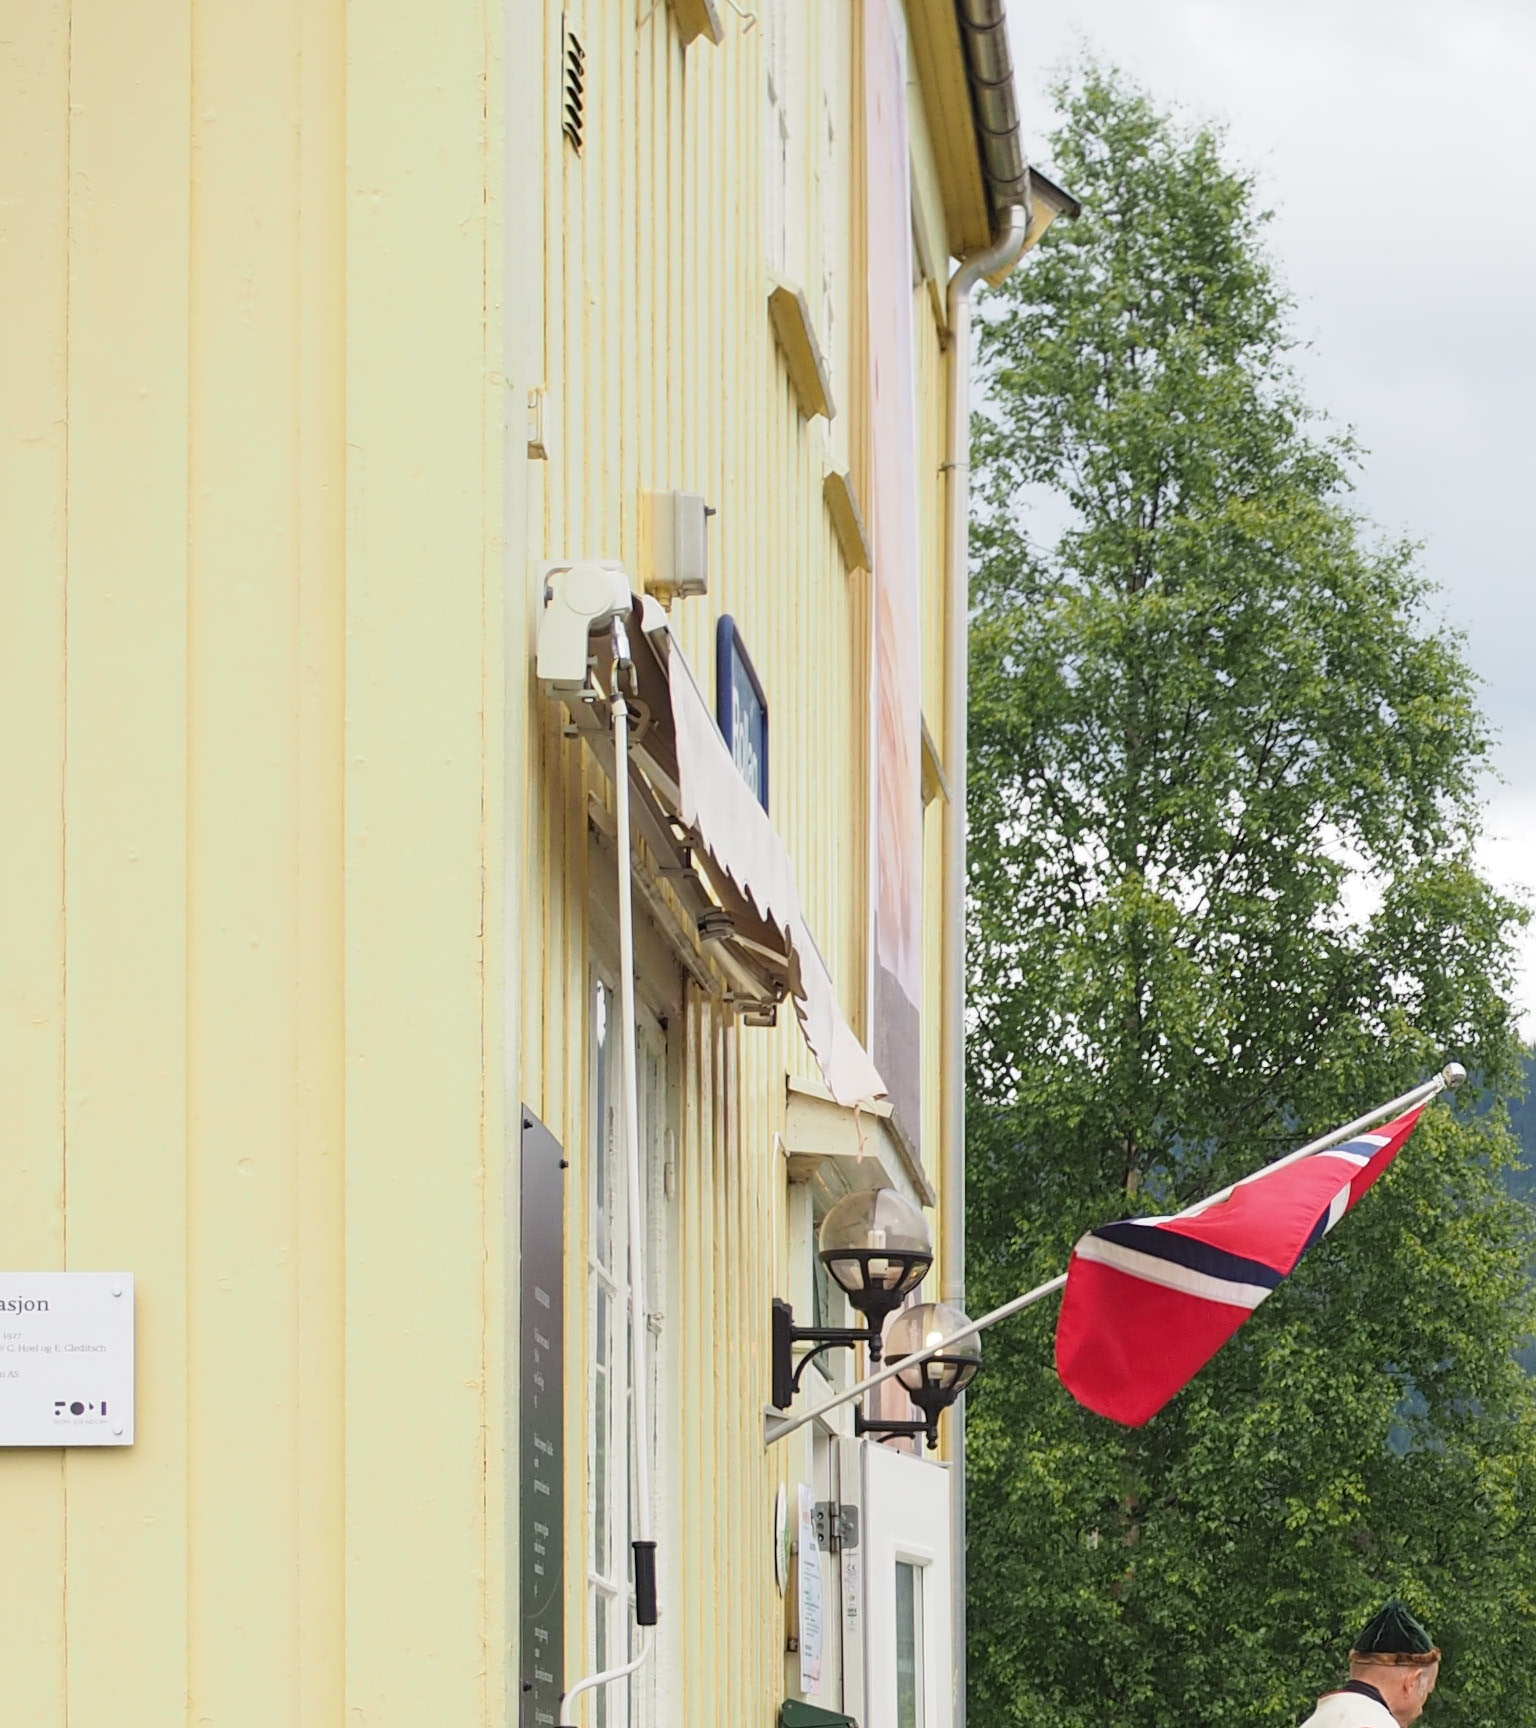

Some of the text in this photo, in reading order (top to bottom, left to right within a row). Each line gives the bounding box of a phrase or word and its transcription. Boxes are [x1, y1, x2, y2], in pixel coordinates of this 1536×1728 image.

[3, 1332, 22, 1341] 1927
[18, 1344, 39, 1352] Hoel
[40, 1345, 52, 1354] og
[64, 1343, 107, 1352] Gleditsch
[7, 1370, 20, 1378] AS
